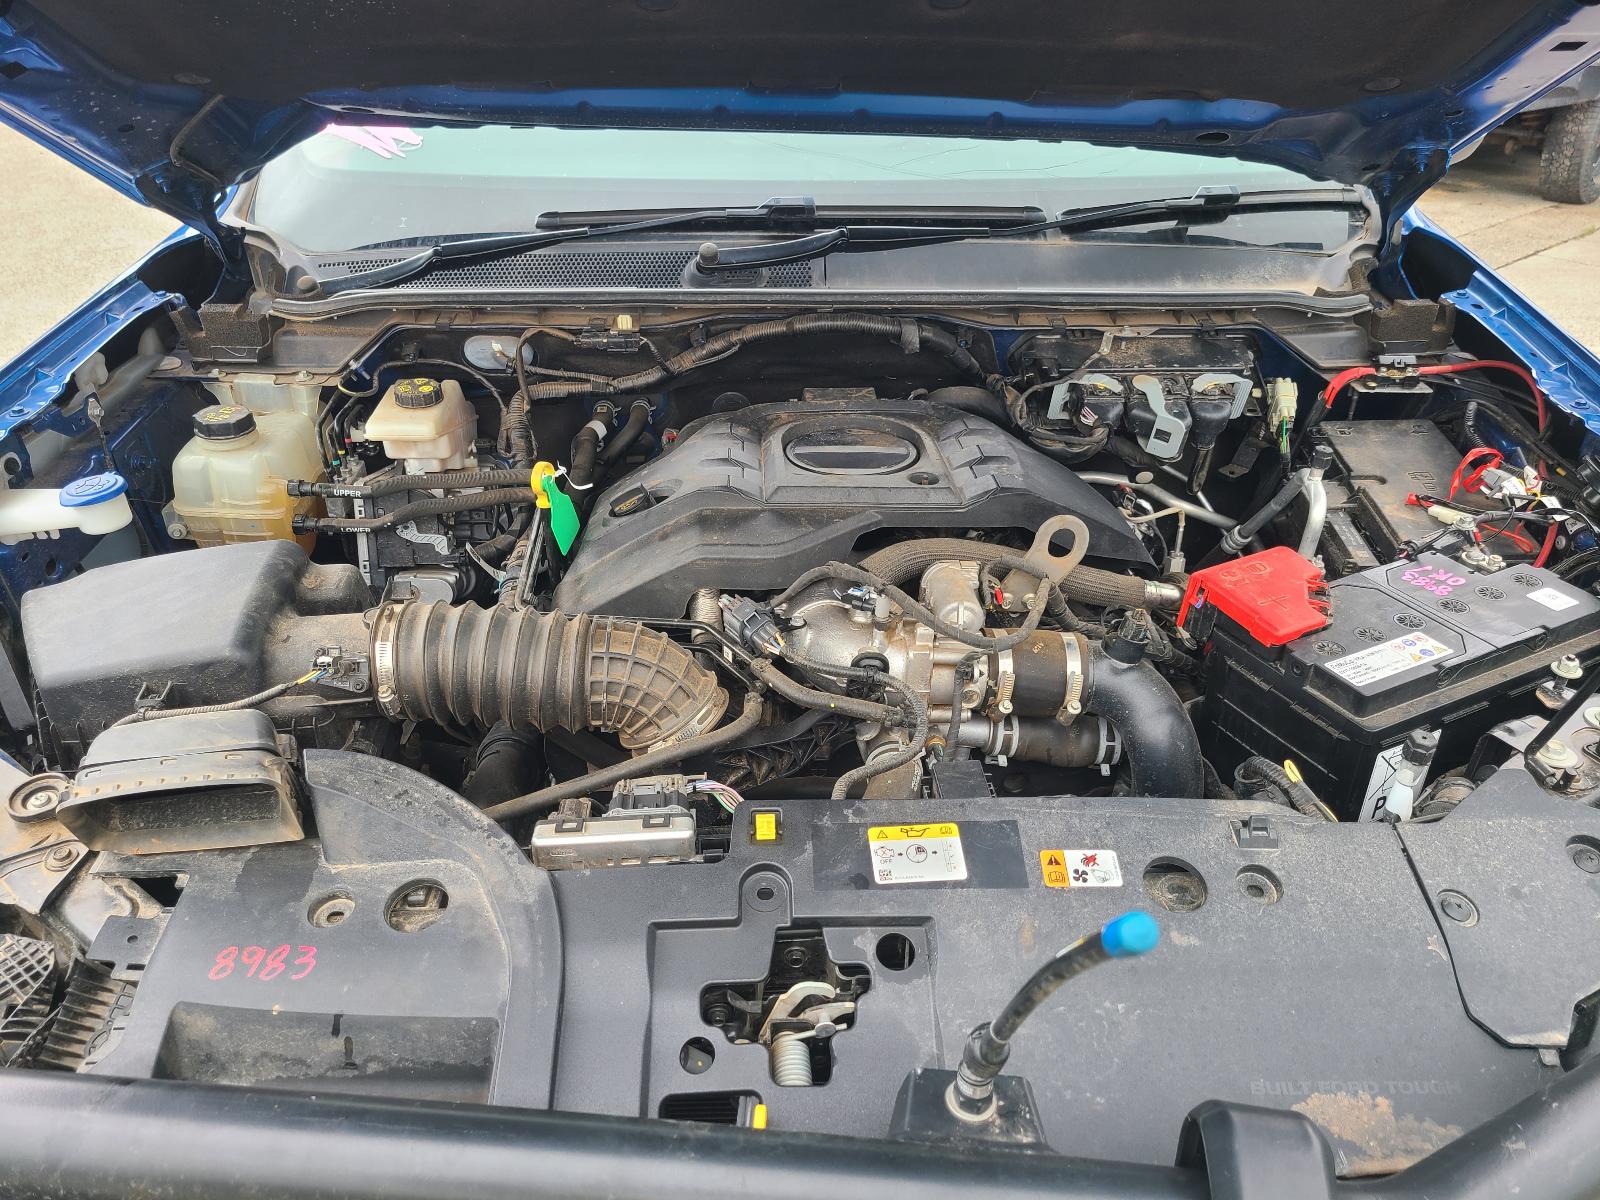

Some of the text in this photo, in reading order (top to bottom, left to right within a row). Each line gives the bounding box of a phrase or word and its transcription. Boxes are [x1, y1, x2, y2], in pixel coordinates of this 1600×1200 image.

[334, 489, 362, 498] UPPER
[207, 943, 318, 981] 8983
[1250, 1079, 1464, 1096] BUILT FORD TOUGH
